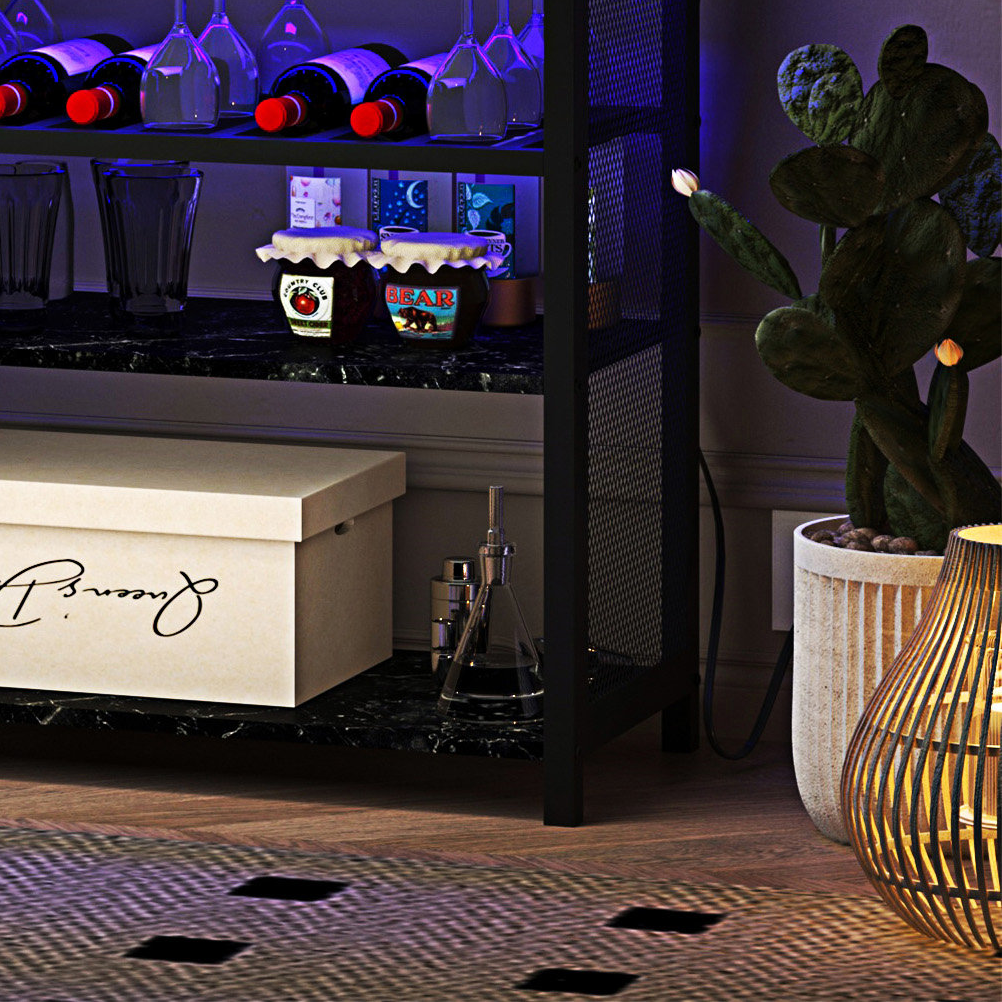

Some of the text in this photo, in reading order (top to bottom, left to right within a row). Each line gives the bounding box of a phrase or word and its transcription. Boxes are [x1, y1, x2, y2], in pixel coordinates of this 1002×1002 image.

[283, 278, 329, 301] COUNTRY CLUB
[385, 286, 455, 308] BEAR
